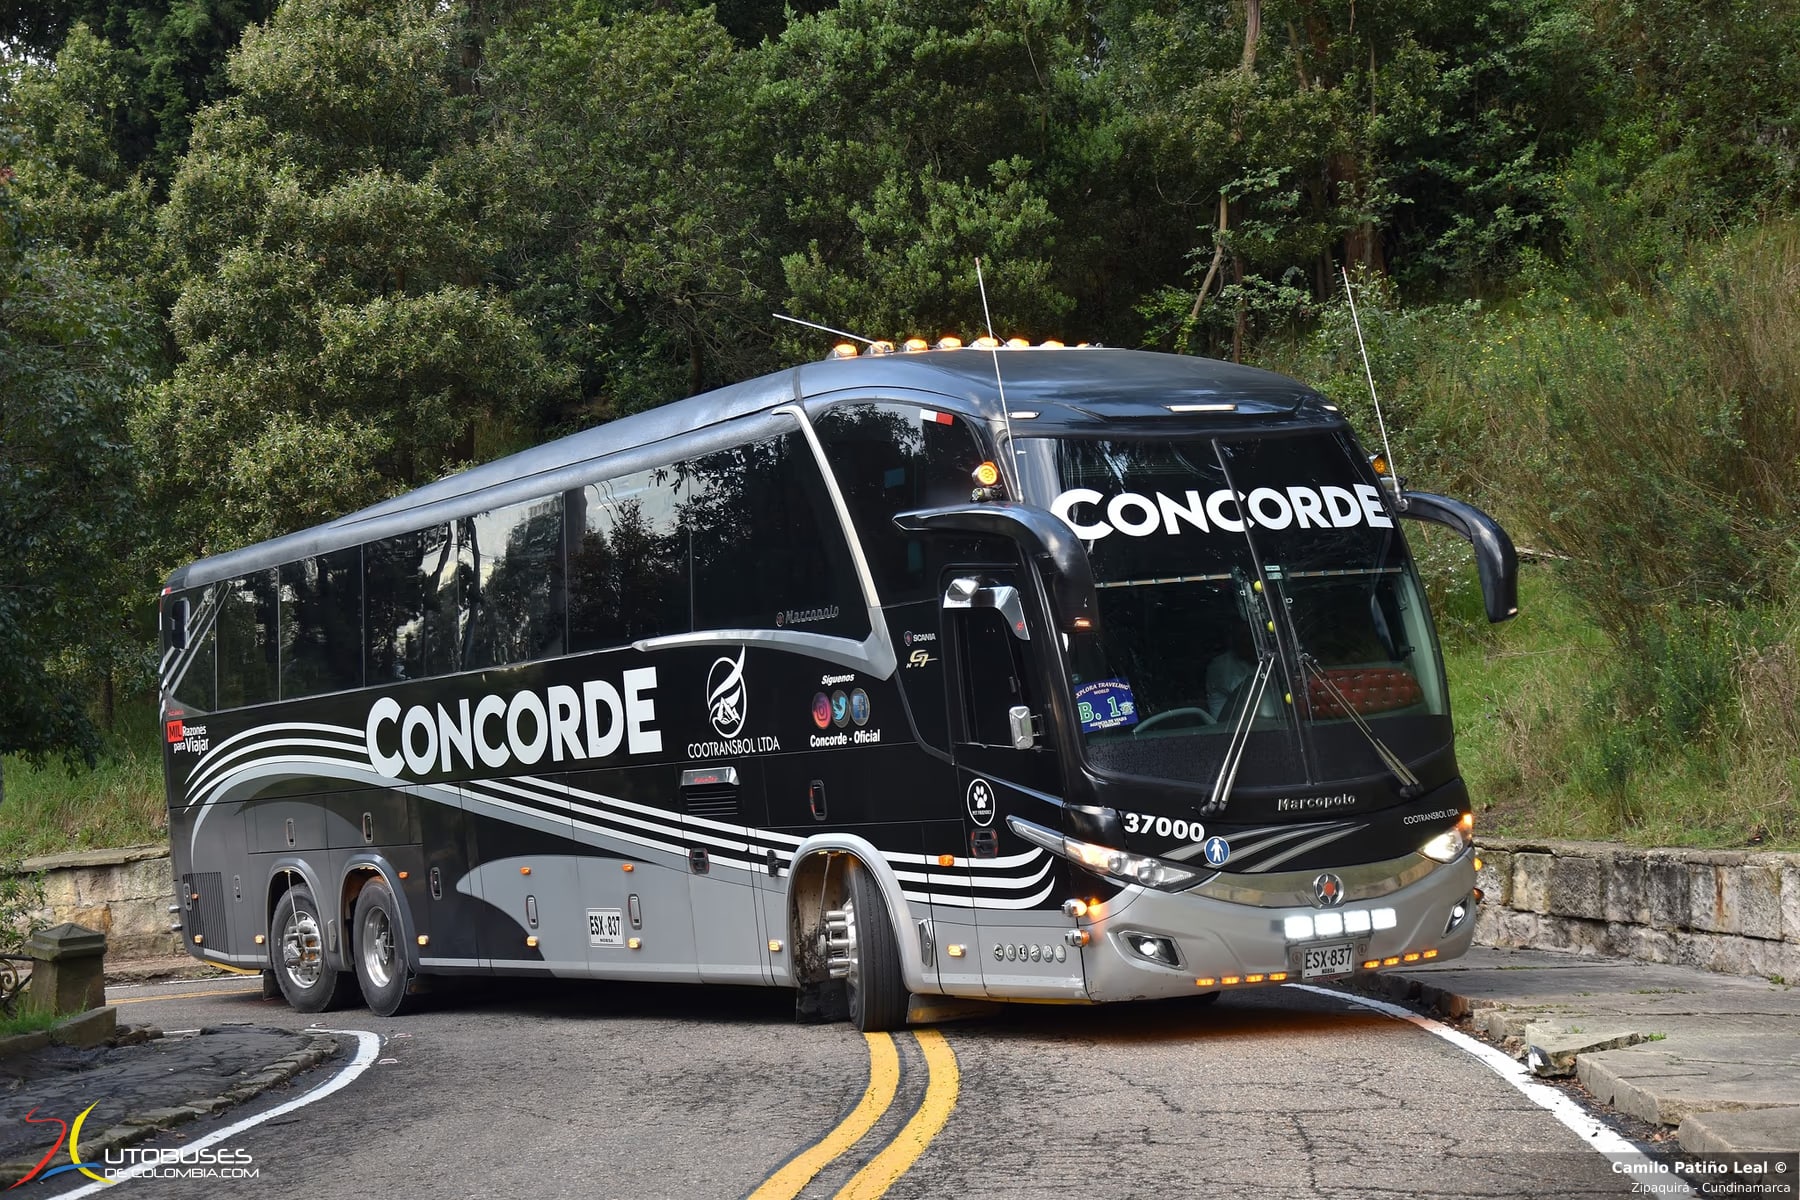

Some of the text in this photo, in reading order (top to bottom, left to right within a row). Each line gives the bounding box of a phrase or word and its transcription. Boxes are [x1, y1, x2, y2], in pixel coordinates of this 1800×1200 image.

[1050, 483, 1394, 541] CONCORDE
[912, 632, 936, 642] SCANIA
[1075, 684, 1097, 699] XPLORA
[366, 666, 663, 778] CONCORDE
[168, 725, 182, 739] MIL
[809, 732, 848, 747] Concorde
[853, 728, 881, 744] Oficial
[173, 735, 210, 756] para Viajar
[687, 735, 781, 759] COOTRANSBOL LTDA
[1278, 793, 1356, 812] Marcopolo
[1403, 808, 1460, 825] COOTRANSBOL LTDA
[1124, 812, 1205, 843] 37000
